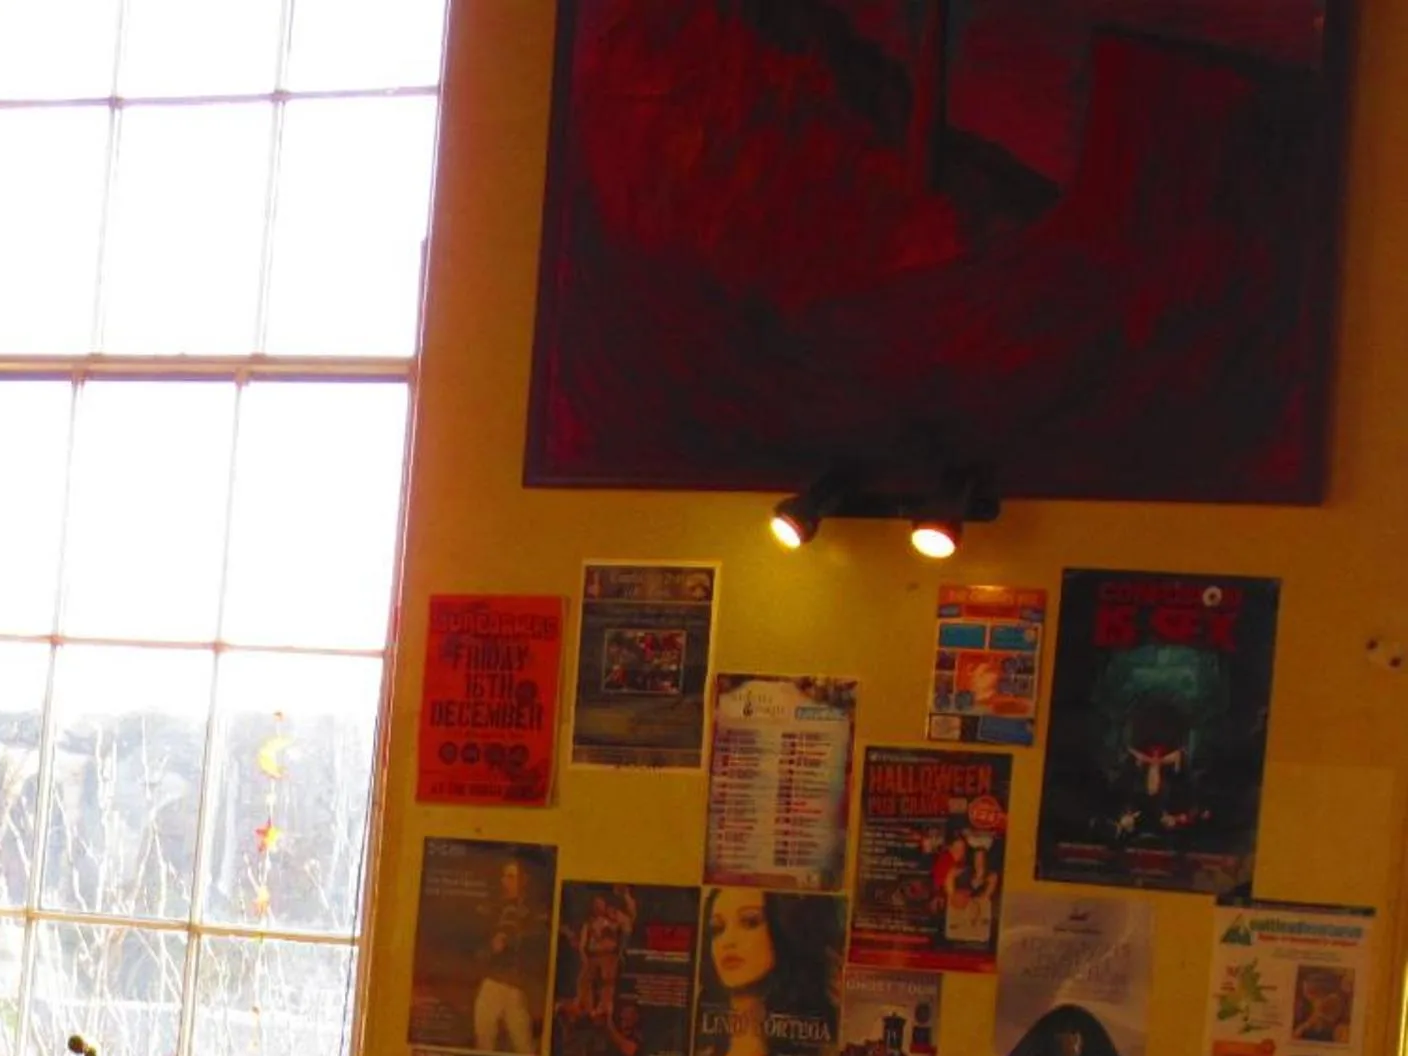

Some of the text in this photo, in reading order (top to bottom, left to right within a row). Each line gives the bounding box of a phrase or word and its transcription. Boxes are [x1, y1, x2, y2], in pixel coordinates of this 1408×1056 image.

[453, 642, 530, 672] FRIDAY
[465, 672, 514, 699] 16TH
[430, 698, 543, 732] DECEMBER
[868, 763, 992, 797] HALLOWEEN
[763, 1018, 831, 1042] ORTEGA
